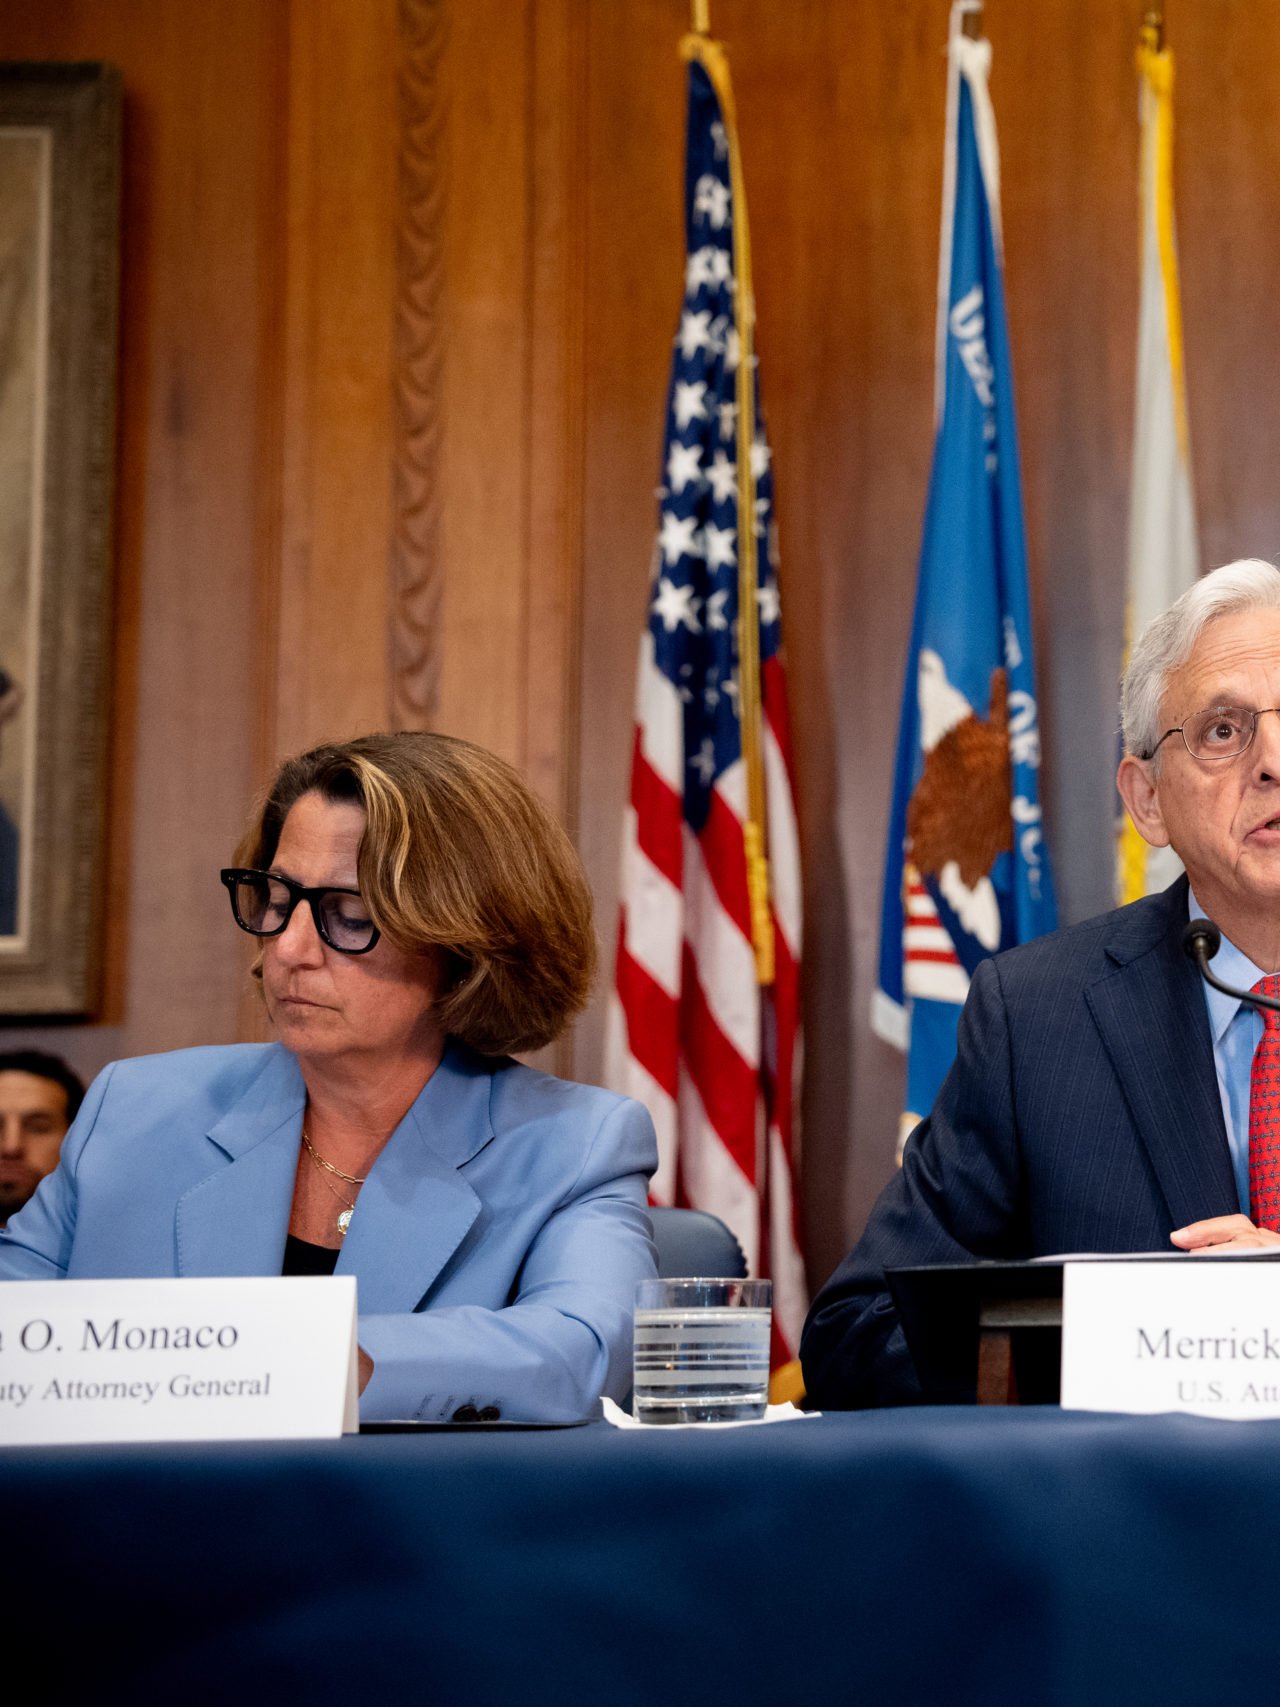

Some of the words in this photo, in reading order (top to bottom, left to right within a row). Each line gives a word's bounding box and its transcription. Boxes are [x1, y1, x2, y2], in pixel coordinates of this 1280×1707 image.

[19, 1318, 62, 1353] O.
[79, 1317, 240, 1352] Monaco
[41, 1376, 160, 1405] Attorney
[168, 1372, 271, 1399] General
[1177, 1380, 1230, 1404] U.S.
